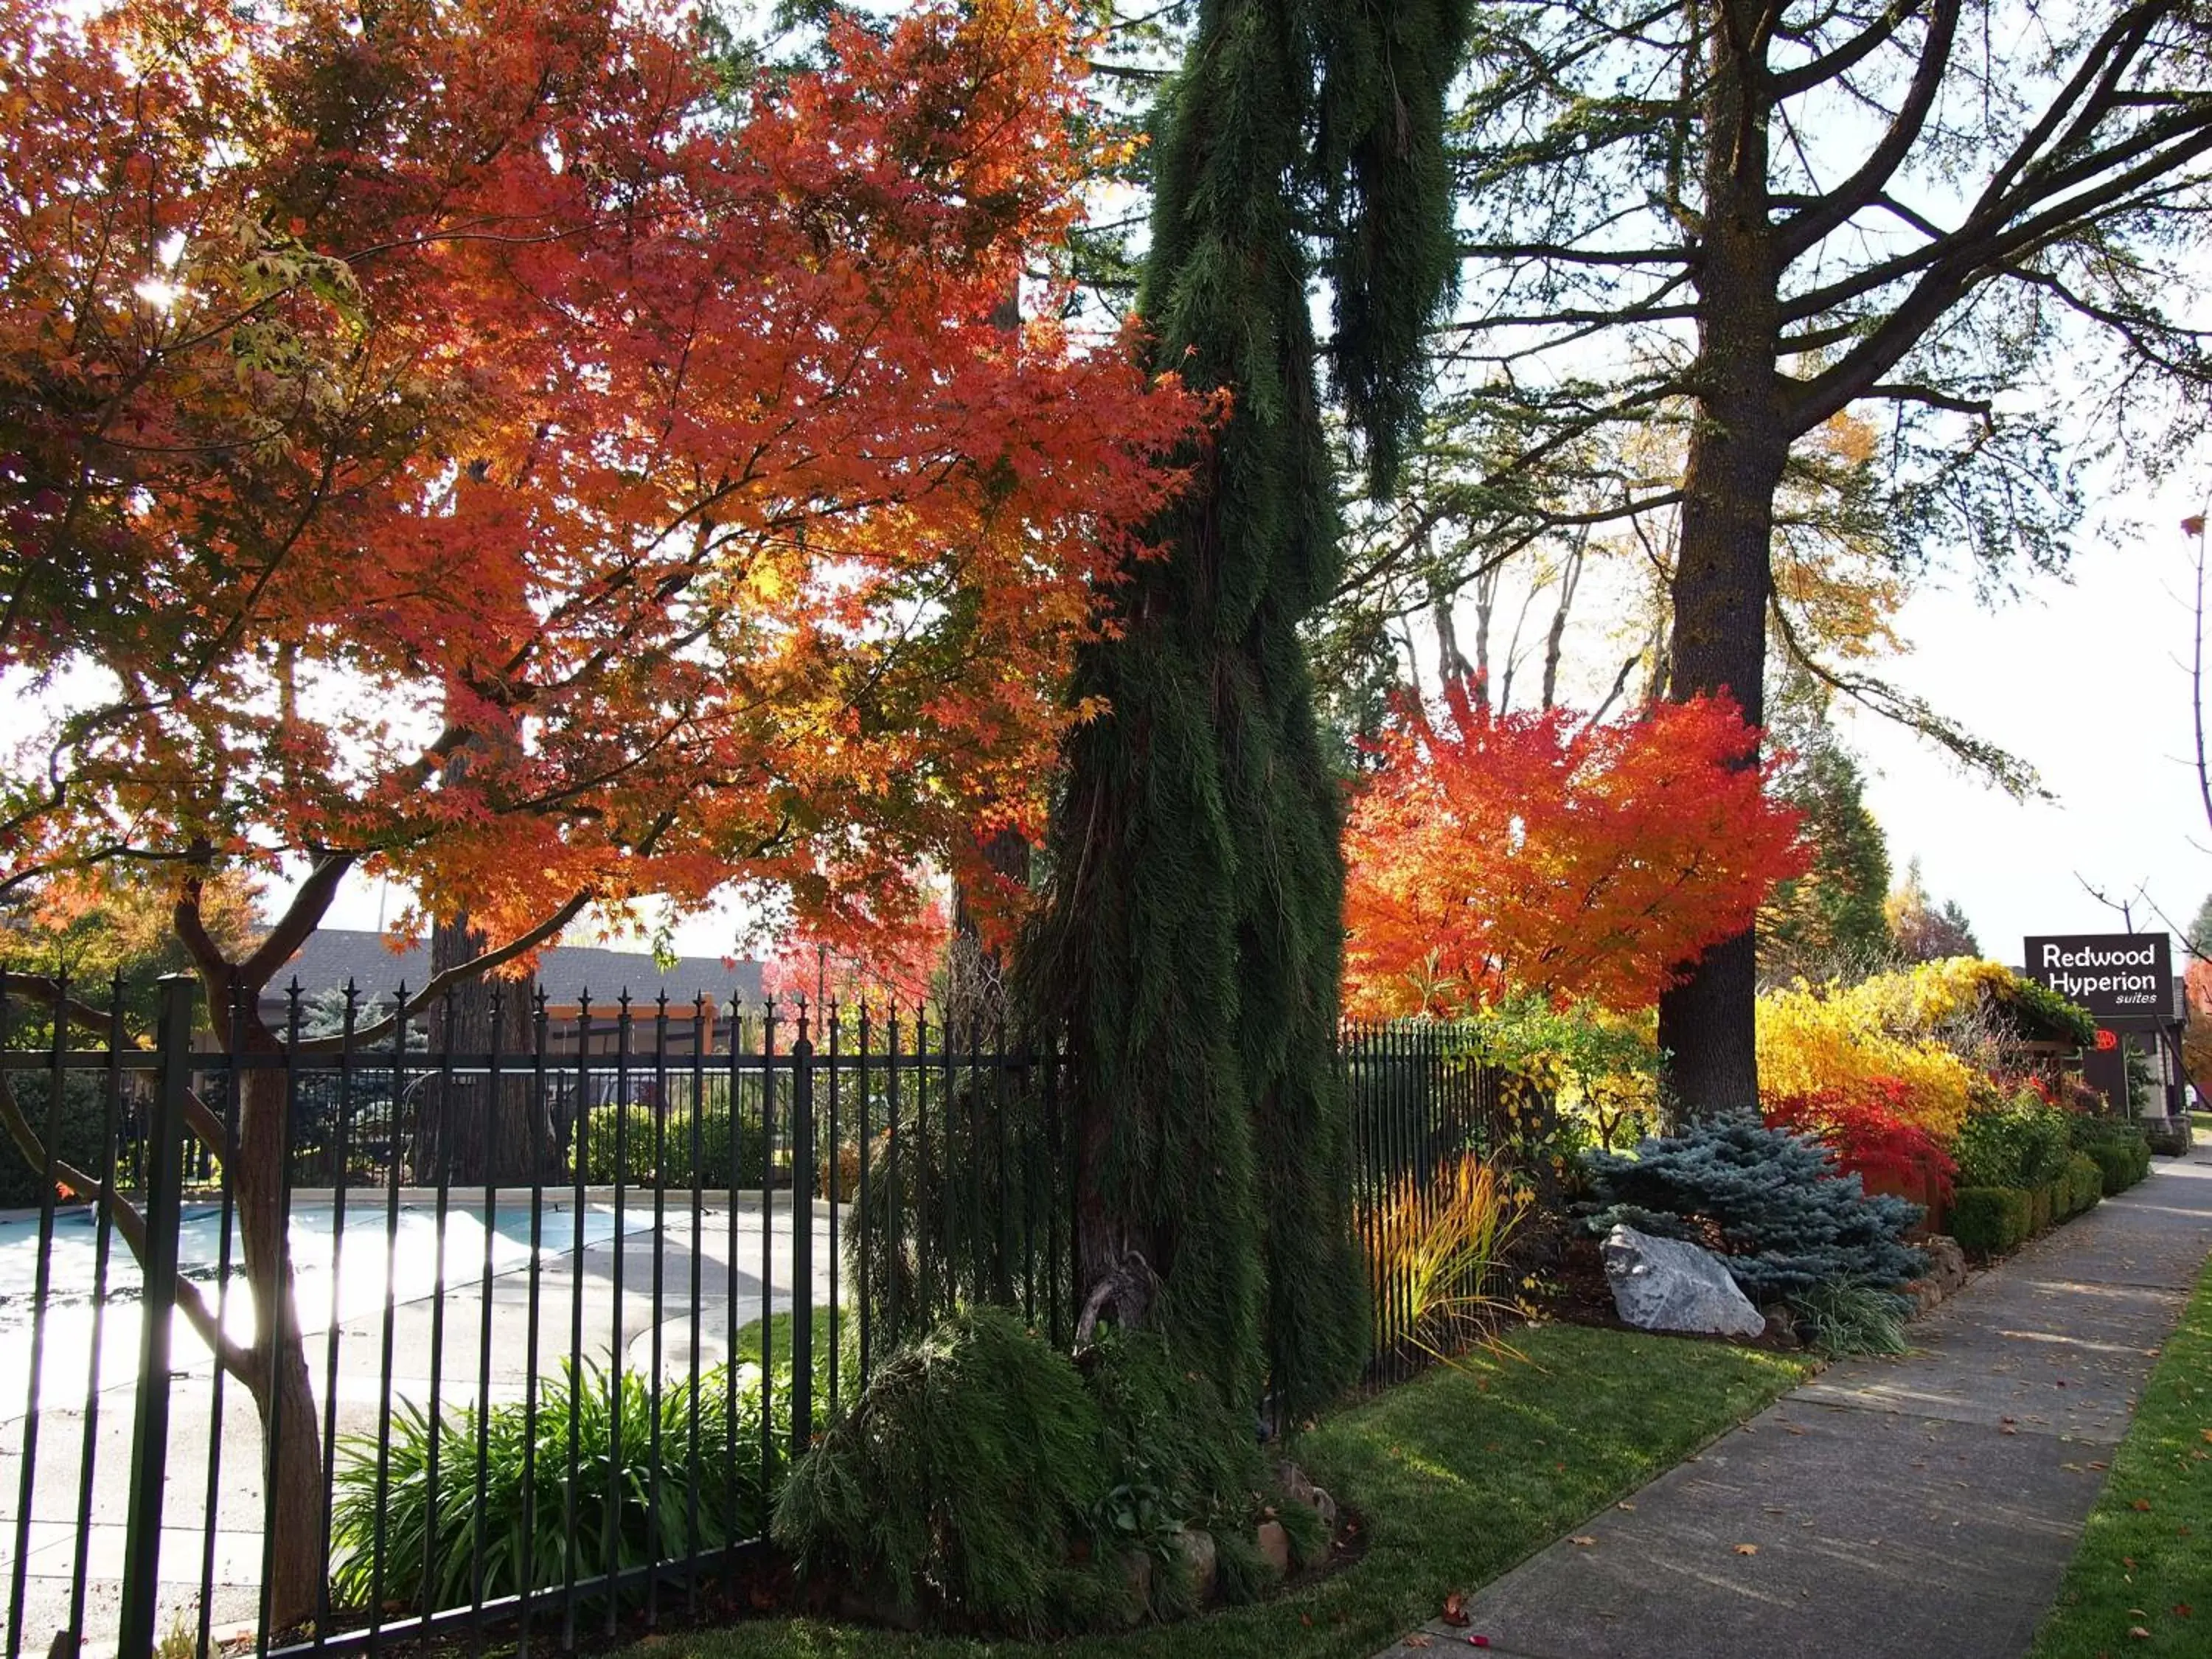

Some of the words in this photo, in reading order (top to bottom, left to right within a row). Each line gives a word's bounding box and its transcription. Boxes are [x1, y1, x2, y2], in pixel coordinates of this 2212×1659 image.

[2042, 944, 2154, 967] Redwood
[2049, 972, 2156, 996] Hyperion
[2115, 992, 2157, 1004] suites
